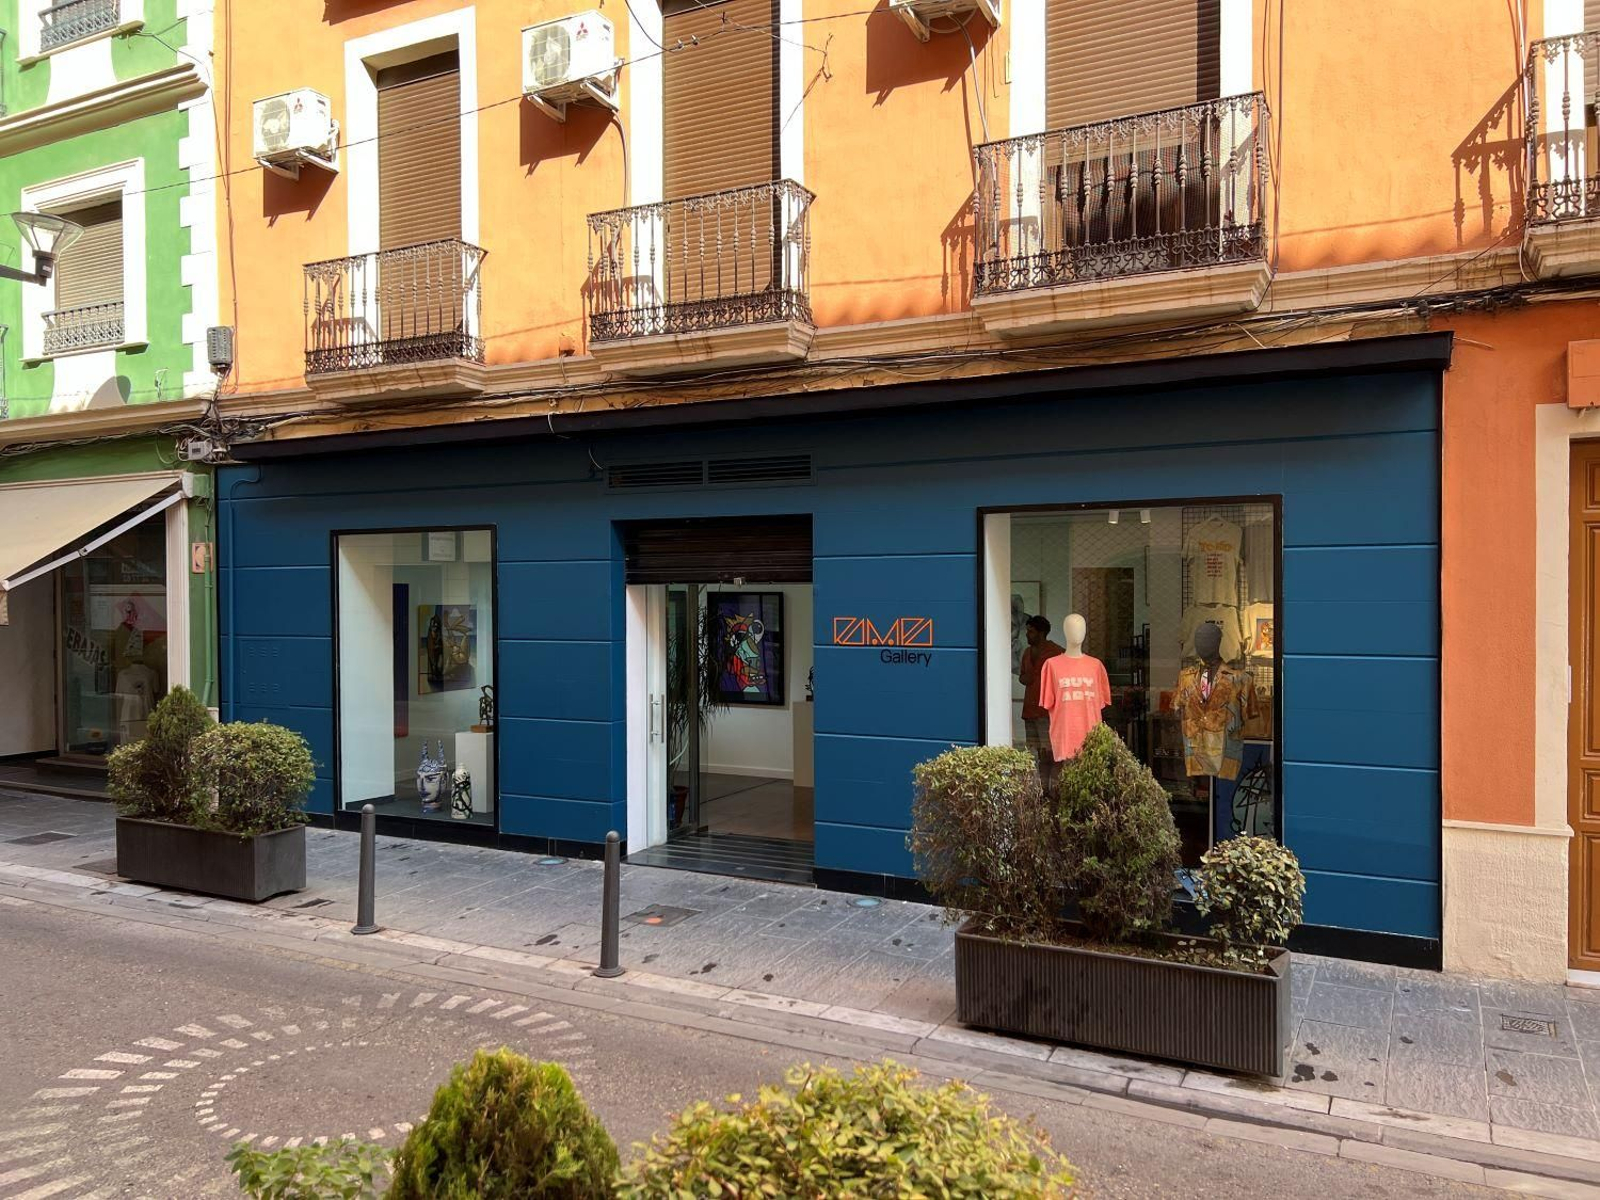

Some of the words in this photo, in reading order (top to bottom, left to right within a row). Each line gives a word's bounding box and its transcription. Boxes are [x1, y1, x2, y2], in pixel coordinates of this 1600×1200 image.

[880, 649, 932, 667] Gallery
[1058, 677, 1094, 688] BUY
[1062, 690, 1095, 702] ART
